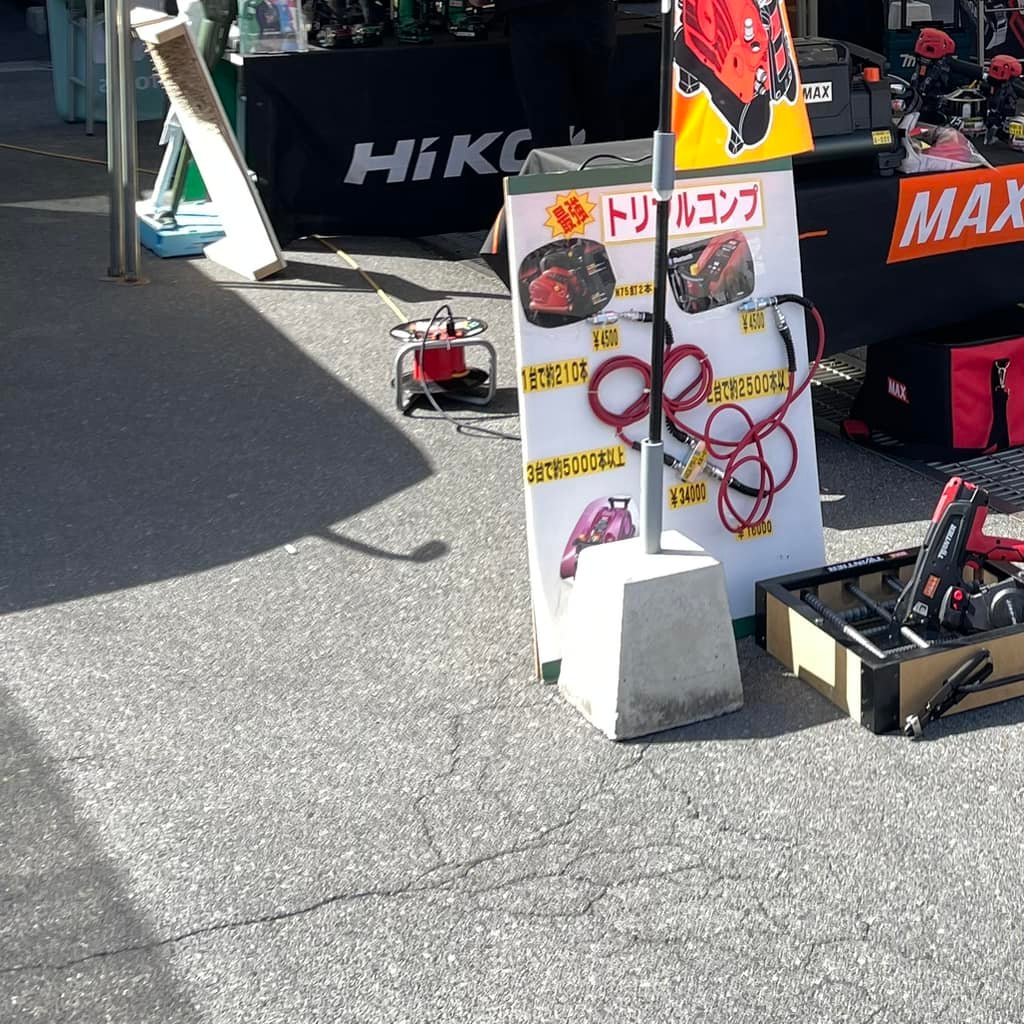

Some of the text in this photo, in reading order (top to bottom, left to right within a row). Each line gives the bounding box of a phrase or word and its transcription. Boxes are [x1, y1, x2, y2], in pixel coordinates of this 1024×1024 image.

[804, 85, 830, 100] MAX
[551, 196, 590, 235] 最強
[608, 183, 759, 237] トリルコンプ
[522, 357, 589, 391] 1台で約210本
[887, 376, 907, 401] MAX
[527, 445, 626, 484] 3台で約5000本以上
[669, 483, 706, 508] ¥34000
